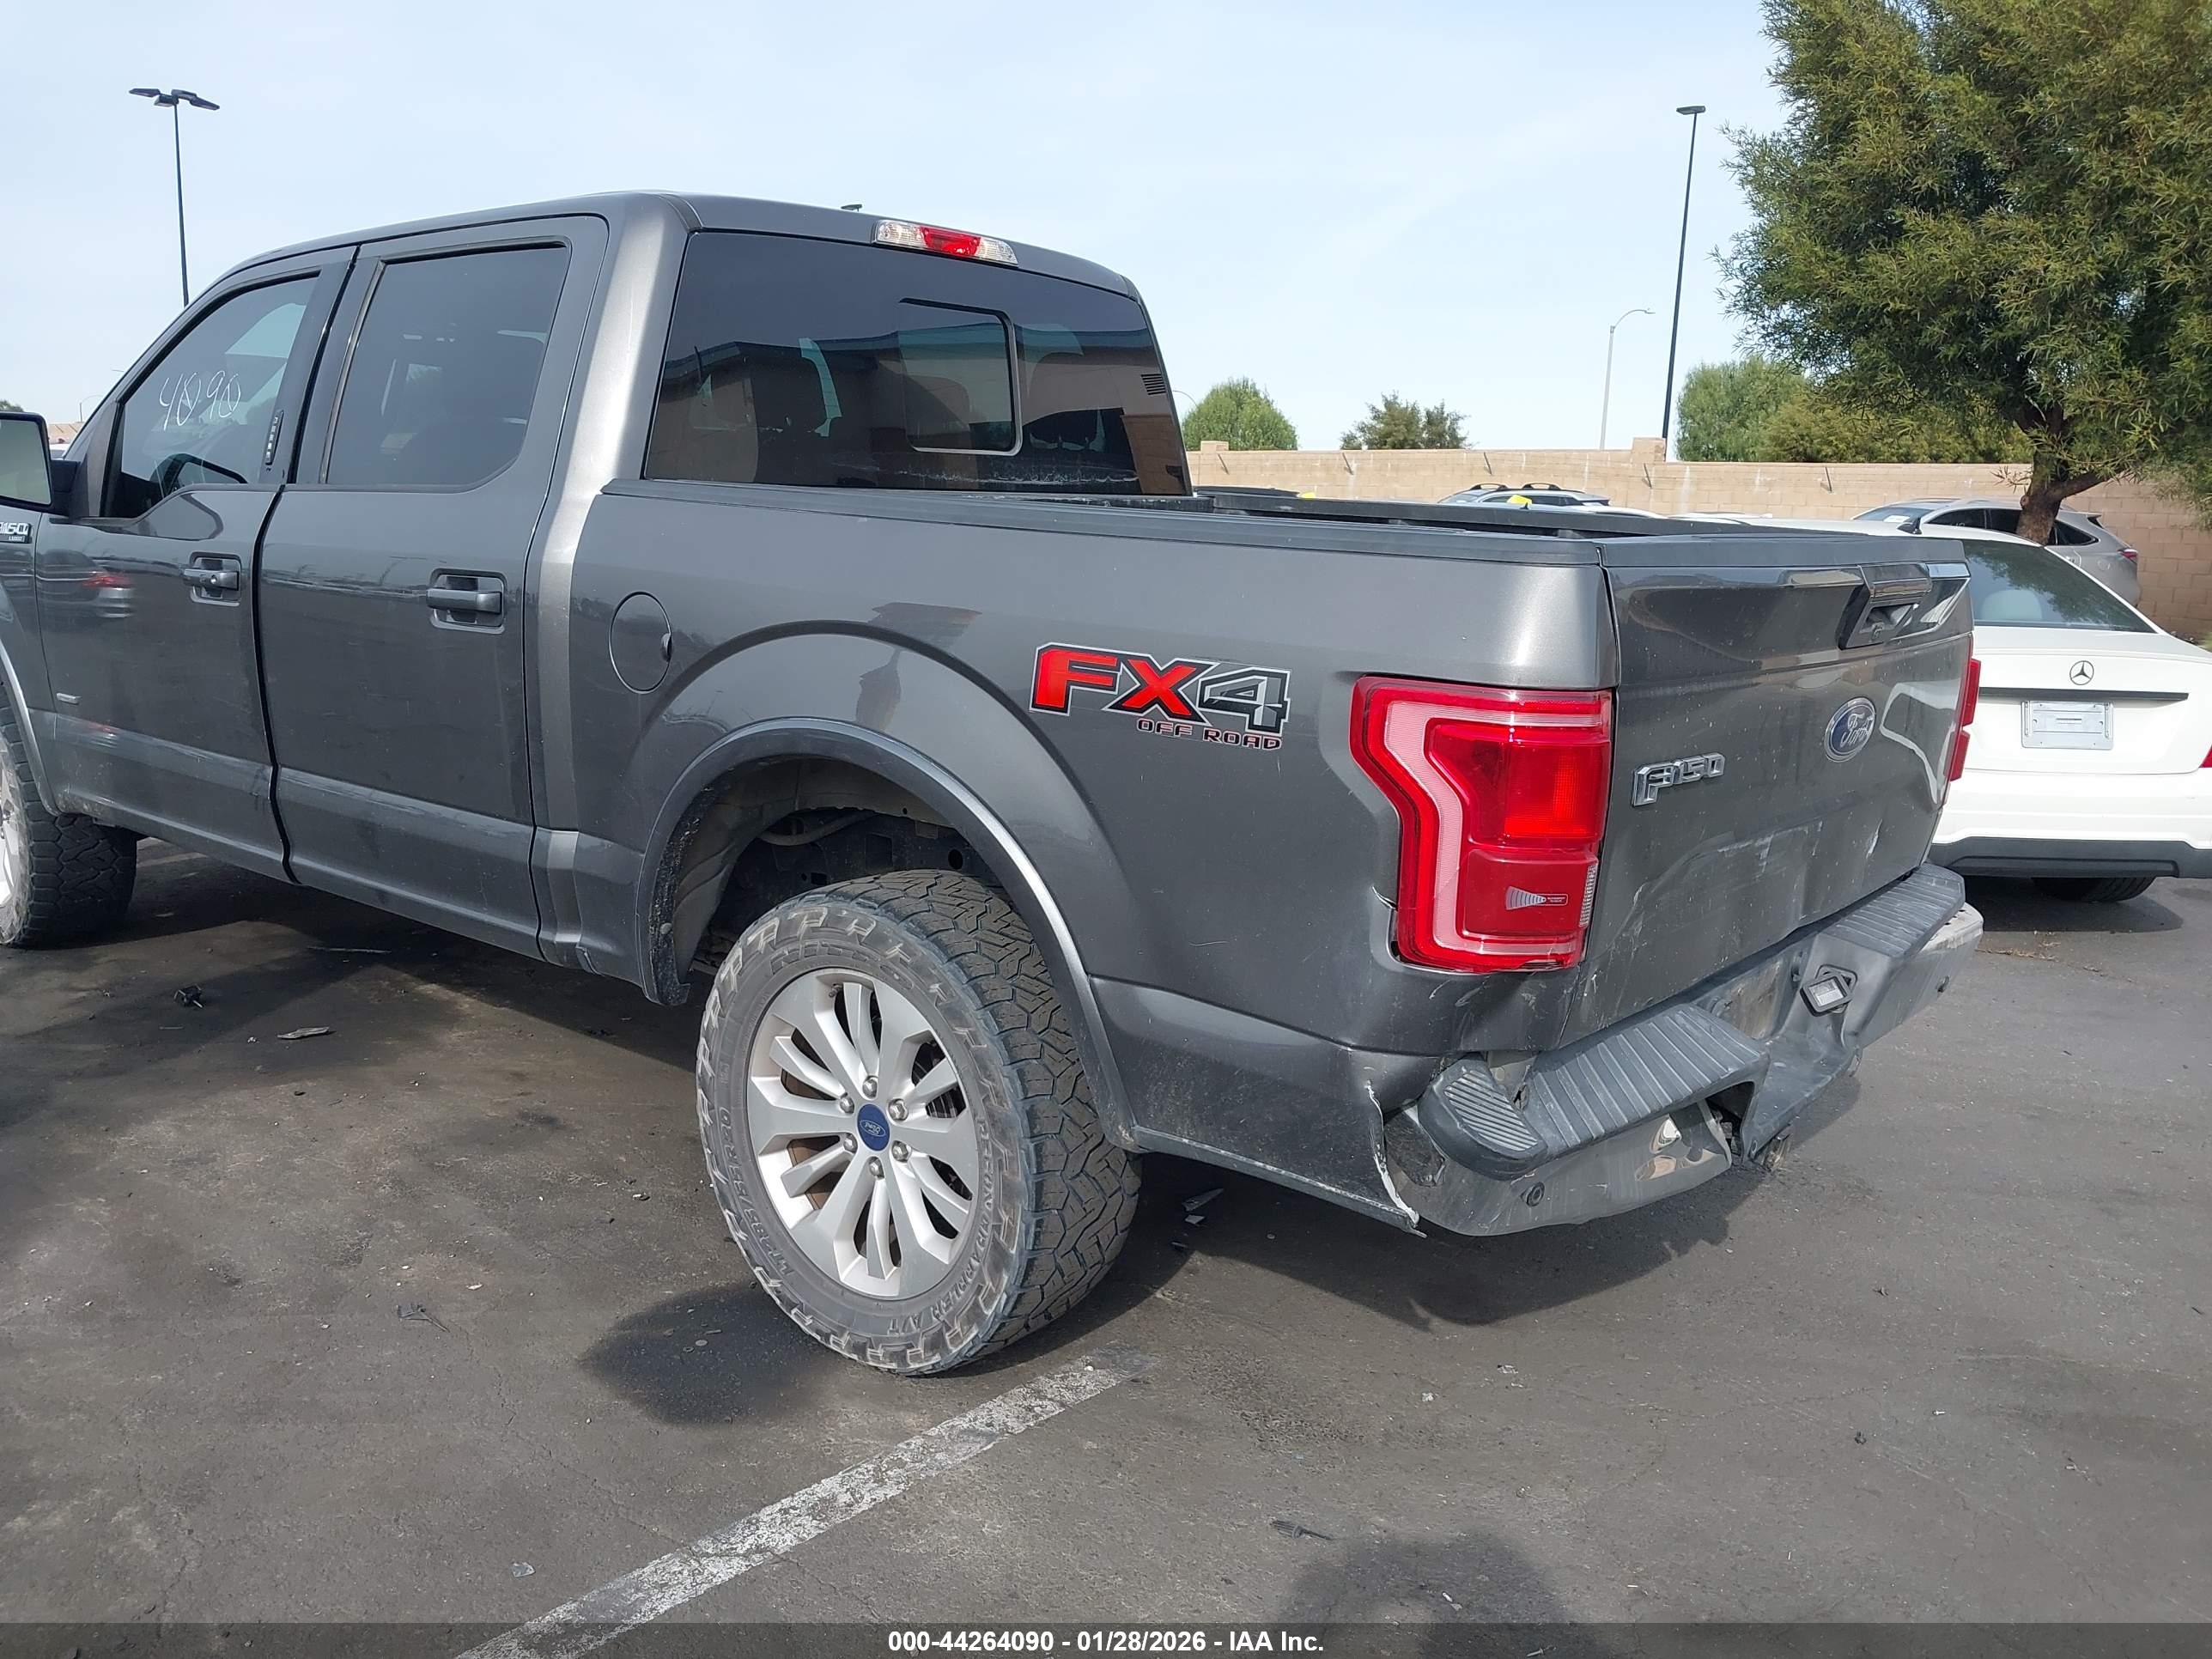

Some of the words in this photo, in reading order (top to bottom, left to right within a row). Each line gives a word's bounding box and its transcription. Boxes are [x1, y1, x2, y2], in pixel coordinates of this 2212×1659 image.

[159, 370, 241, 431] 4090
[1030, 642, 1291, 737] FX4
[1136, 717, 1193, 737] OFF
[1202, 726, 1283, 750] ROAD
